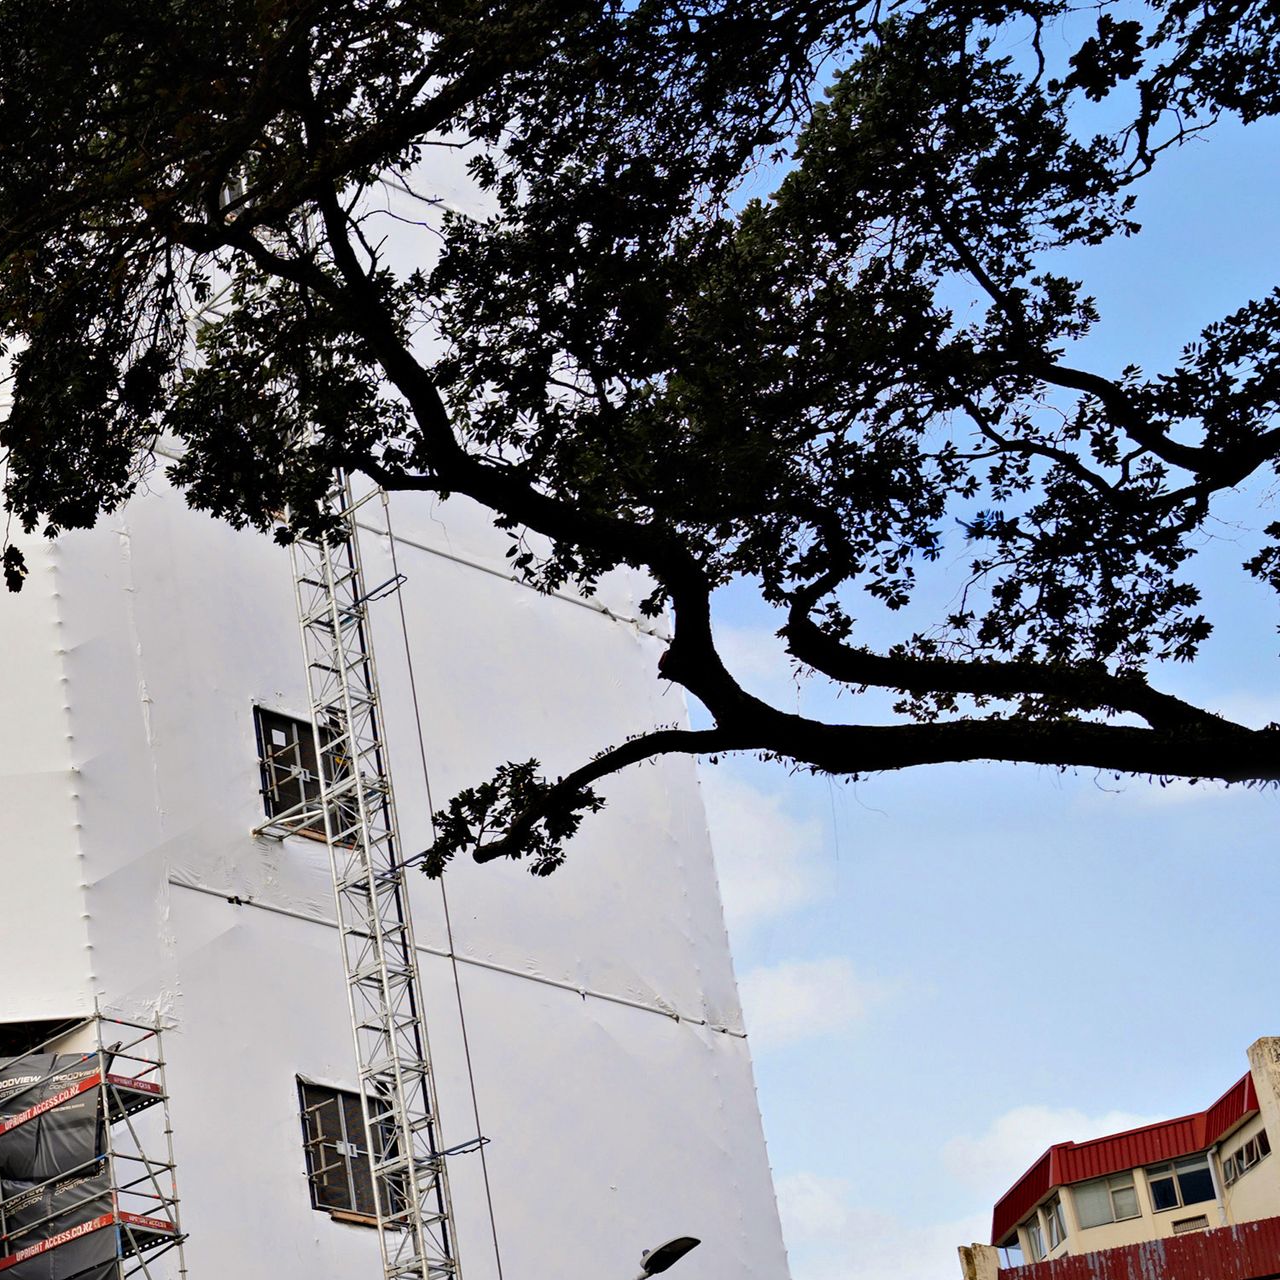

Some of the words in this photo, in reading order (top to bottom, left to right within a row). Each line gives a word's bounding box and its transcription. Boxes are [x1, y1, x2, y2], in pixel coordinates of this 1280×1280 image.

[5, 1108, 32, 1130] UPRIGHT
[33, 1084, 80, 1117] ACCESS.CO.NZ
[15, 1242, 43, 1262] UPRIGHT
[45, 1221, 93, 1250] ACCESS.CO.NZ
